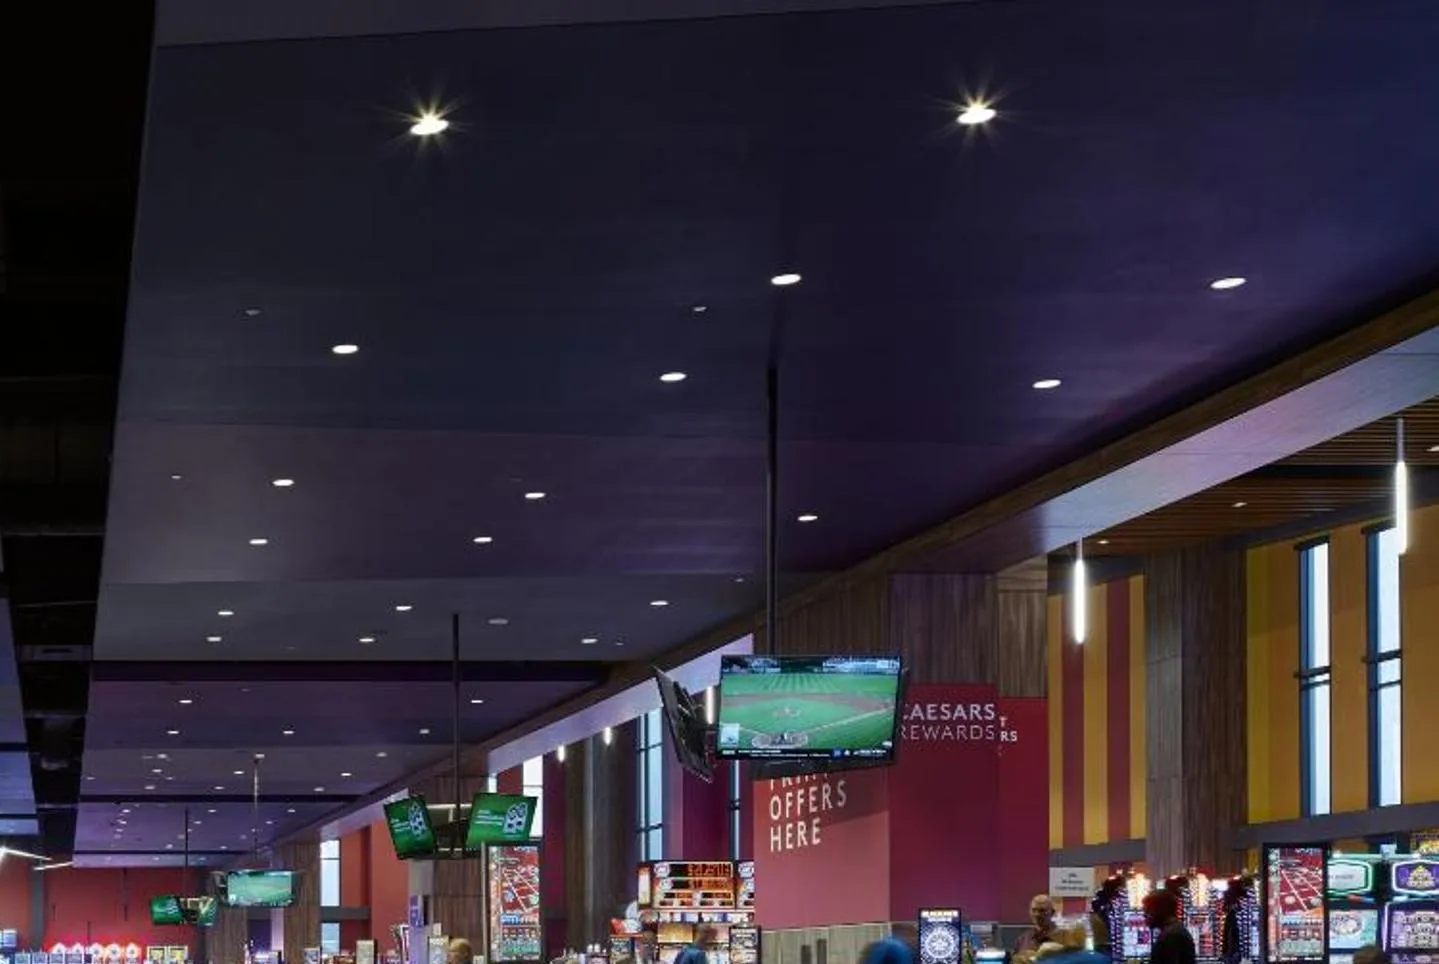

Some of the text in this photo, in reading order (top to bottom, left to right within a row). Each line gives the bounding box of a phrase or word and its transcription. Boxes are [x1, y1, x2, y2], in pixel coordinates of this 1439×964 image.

[903, 703, 995, 720] AESARS
[770, 780, 847, 820] OFFERS
[770, 817, 821, 853] HERE
